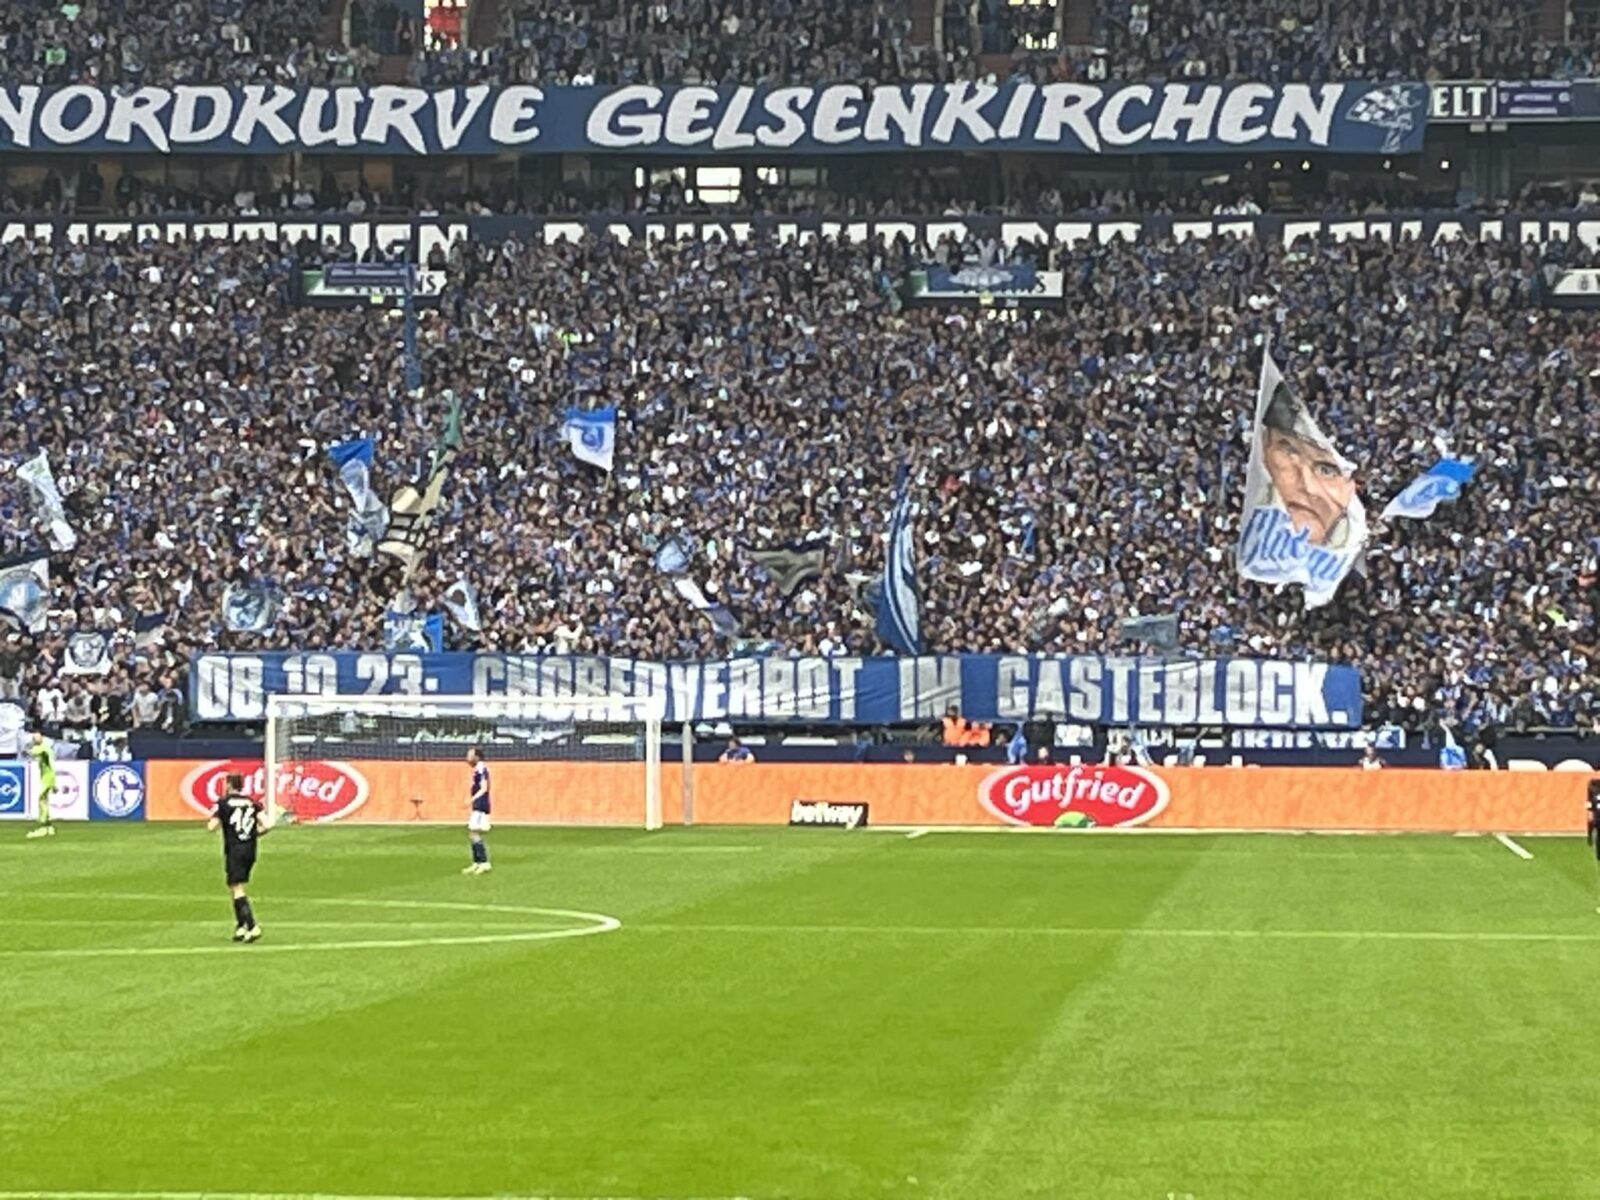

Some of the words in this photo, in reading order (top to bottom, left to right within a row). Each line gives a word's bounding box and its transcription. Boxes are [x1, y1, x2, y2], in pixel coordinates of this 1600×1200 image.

[0, 83, 544, 154] NORDKURVE
[586, 80, 1343, 153] GELSENKIRCHEN
[898, 656, 962, 721] IM
[1004, 767, 1147, 816] Gutfried
